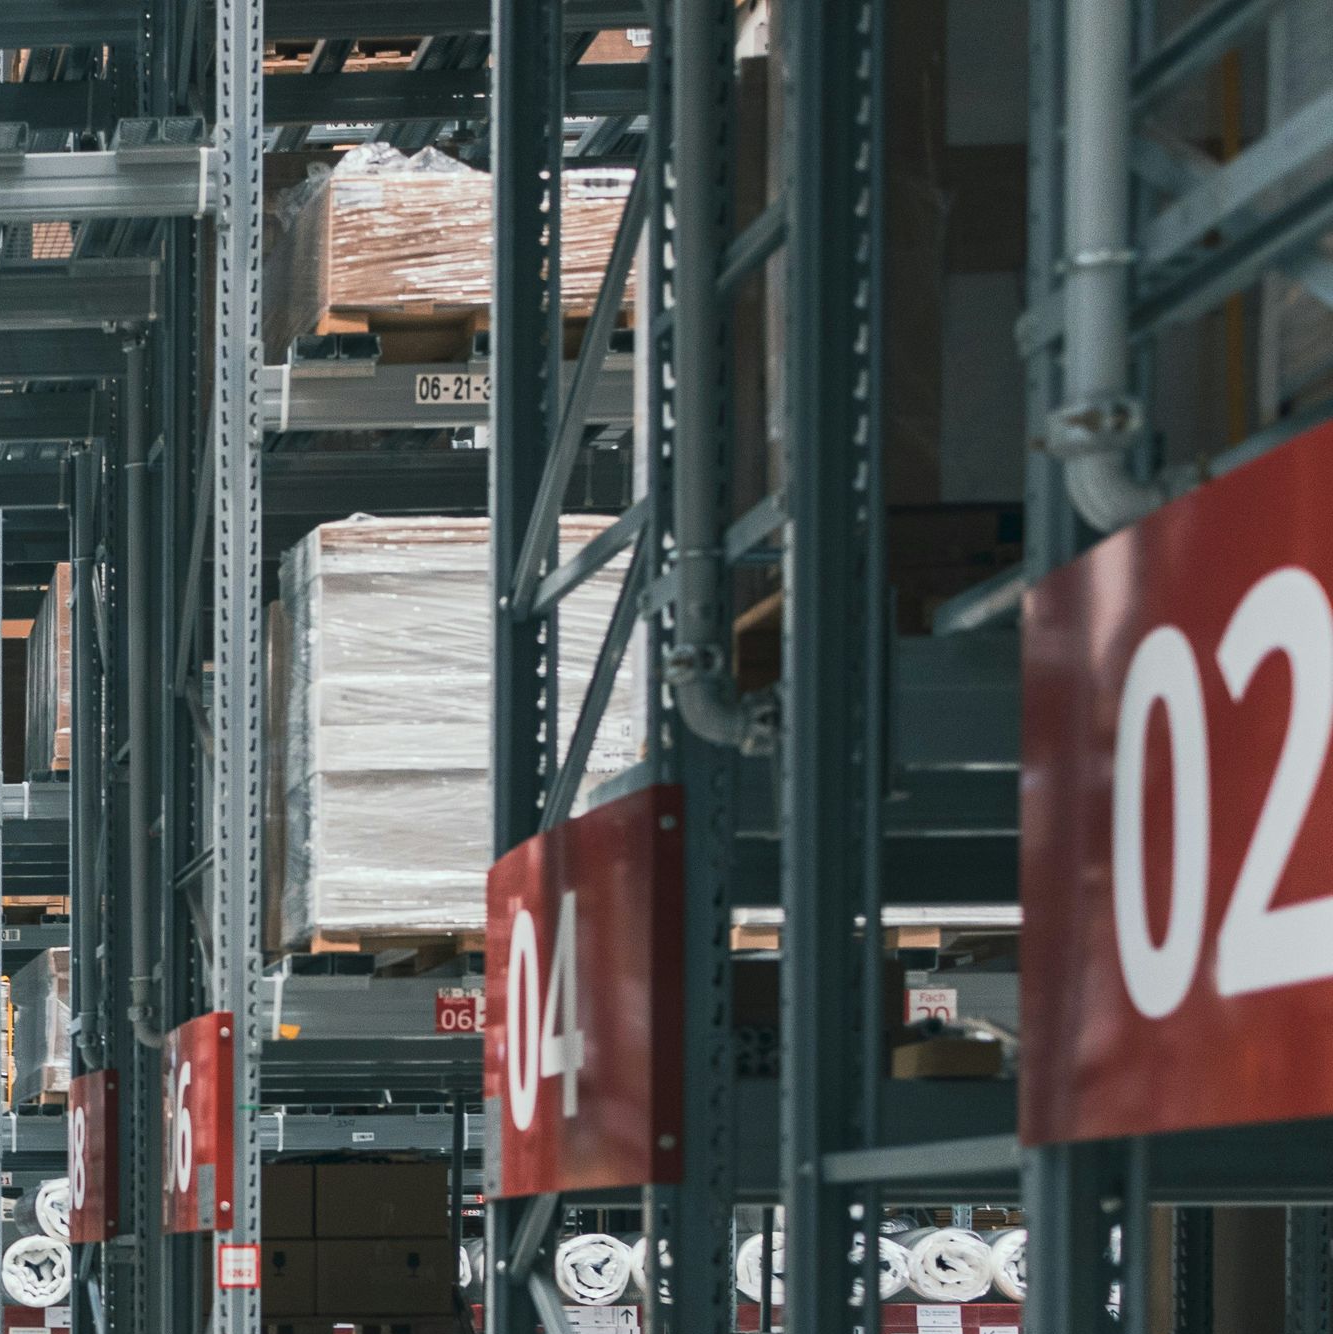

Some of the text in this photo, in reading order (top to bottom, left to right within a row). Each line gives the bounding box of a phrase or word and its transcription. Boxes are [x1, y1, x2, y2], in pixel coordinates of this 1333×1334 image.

[1112, 566, 1333, 1019] 02
[441, 1009, 472, 1030] 06
[508, 890, 584, 1131] 04
[919, 992, 946, 1002] Fach
